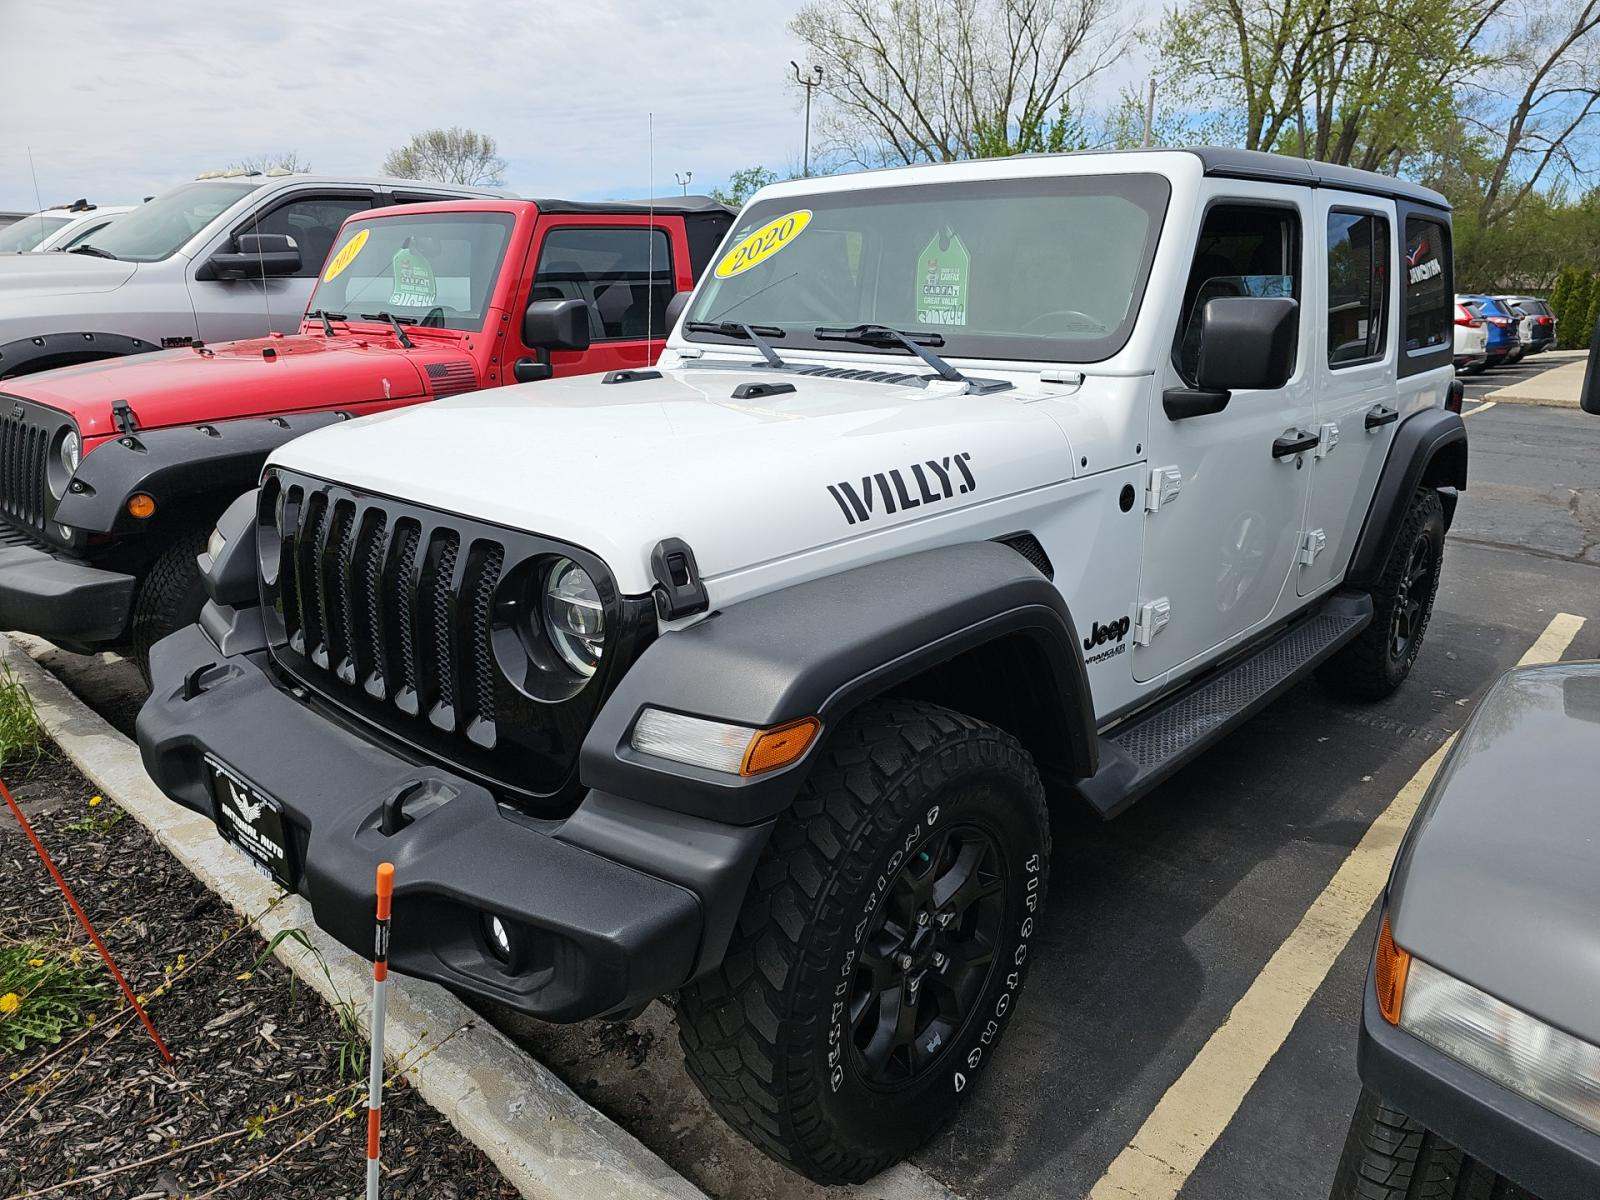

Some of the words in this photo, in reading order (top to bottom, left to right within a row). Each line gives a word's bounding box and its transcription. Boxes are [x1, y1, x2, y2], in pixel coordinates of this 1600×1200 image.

[731, 218, 795, 272] 2020
[923, 285, 960, 296] CARFAX
[826, 452, 976, 525] WILLYS
[1083, 616, 1130, 651] Jeep
[221, 802, 259, 841] NATIONAL
[260, 834, 284, 860] AUTO
